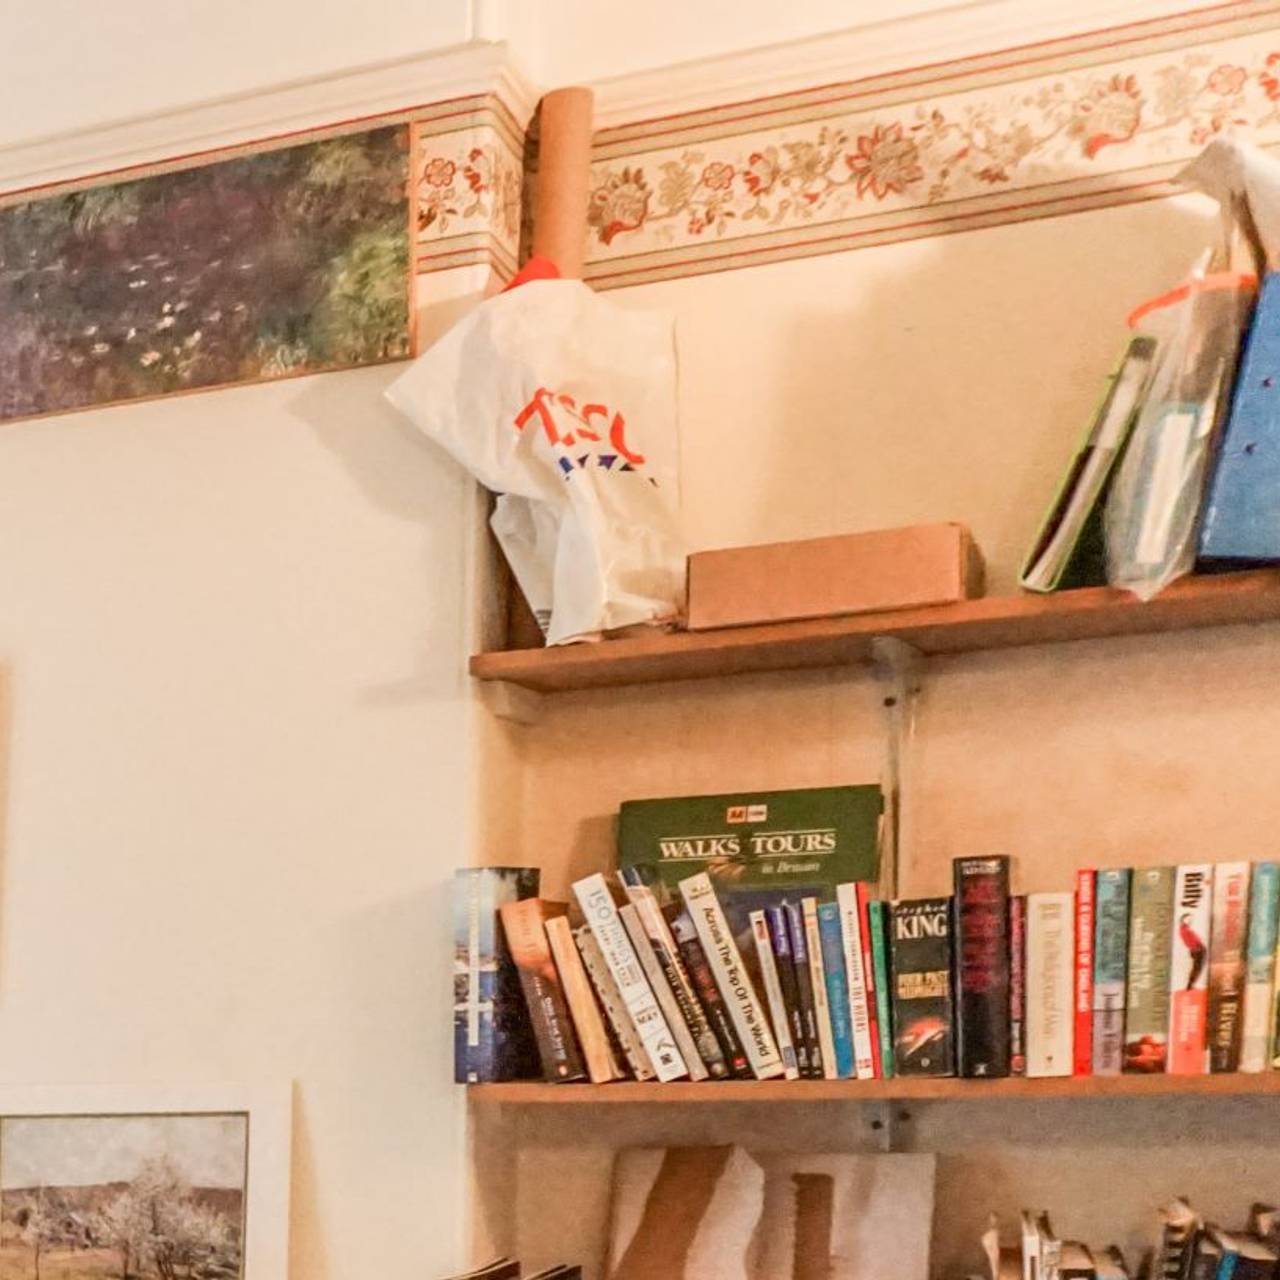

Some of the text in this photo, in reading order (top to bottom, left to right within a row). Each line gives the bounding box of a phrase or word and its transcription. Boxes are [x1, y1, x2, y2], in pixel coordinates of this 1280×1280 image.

[659, 833, 836, 858] WALKS TOURS
[1181, 872, 1202, 907] Billy
[897, 914, 947, 939] KING
[702, 904, 771, 1057] Across The Top Of The World
